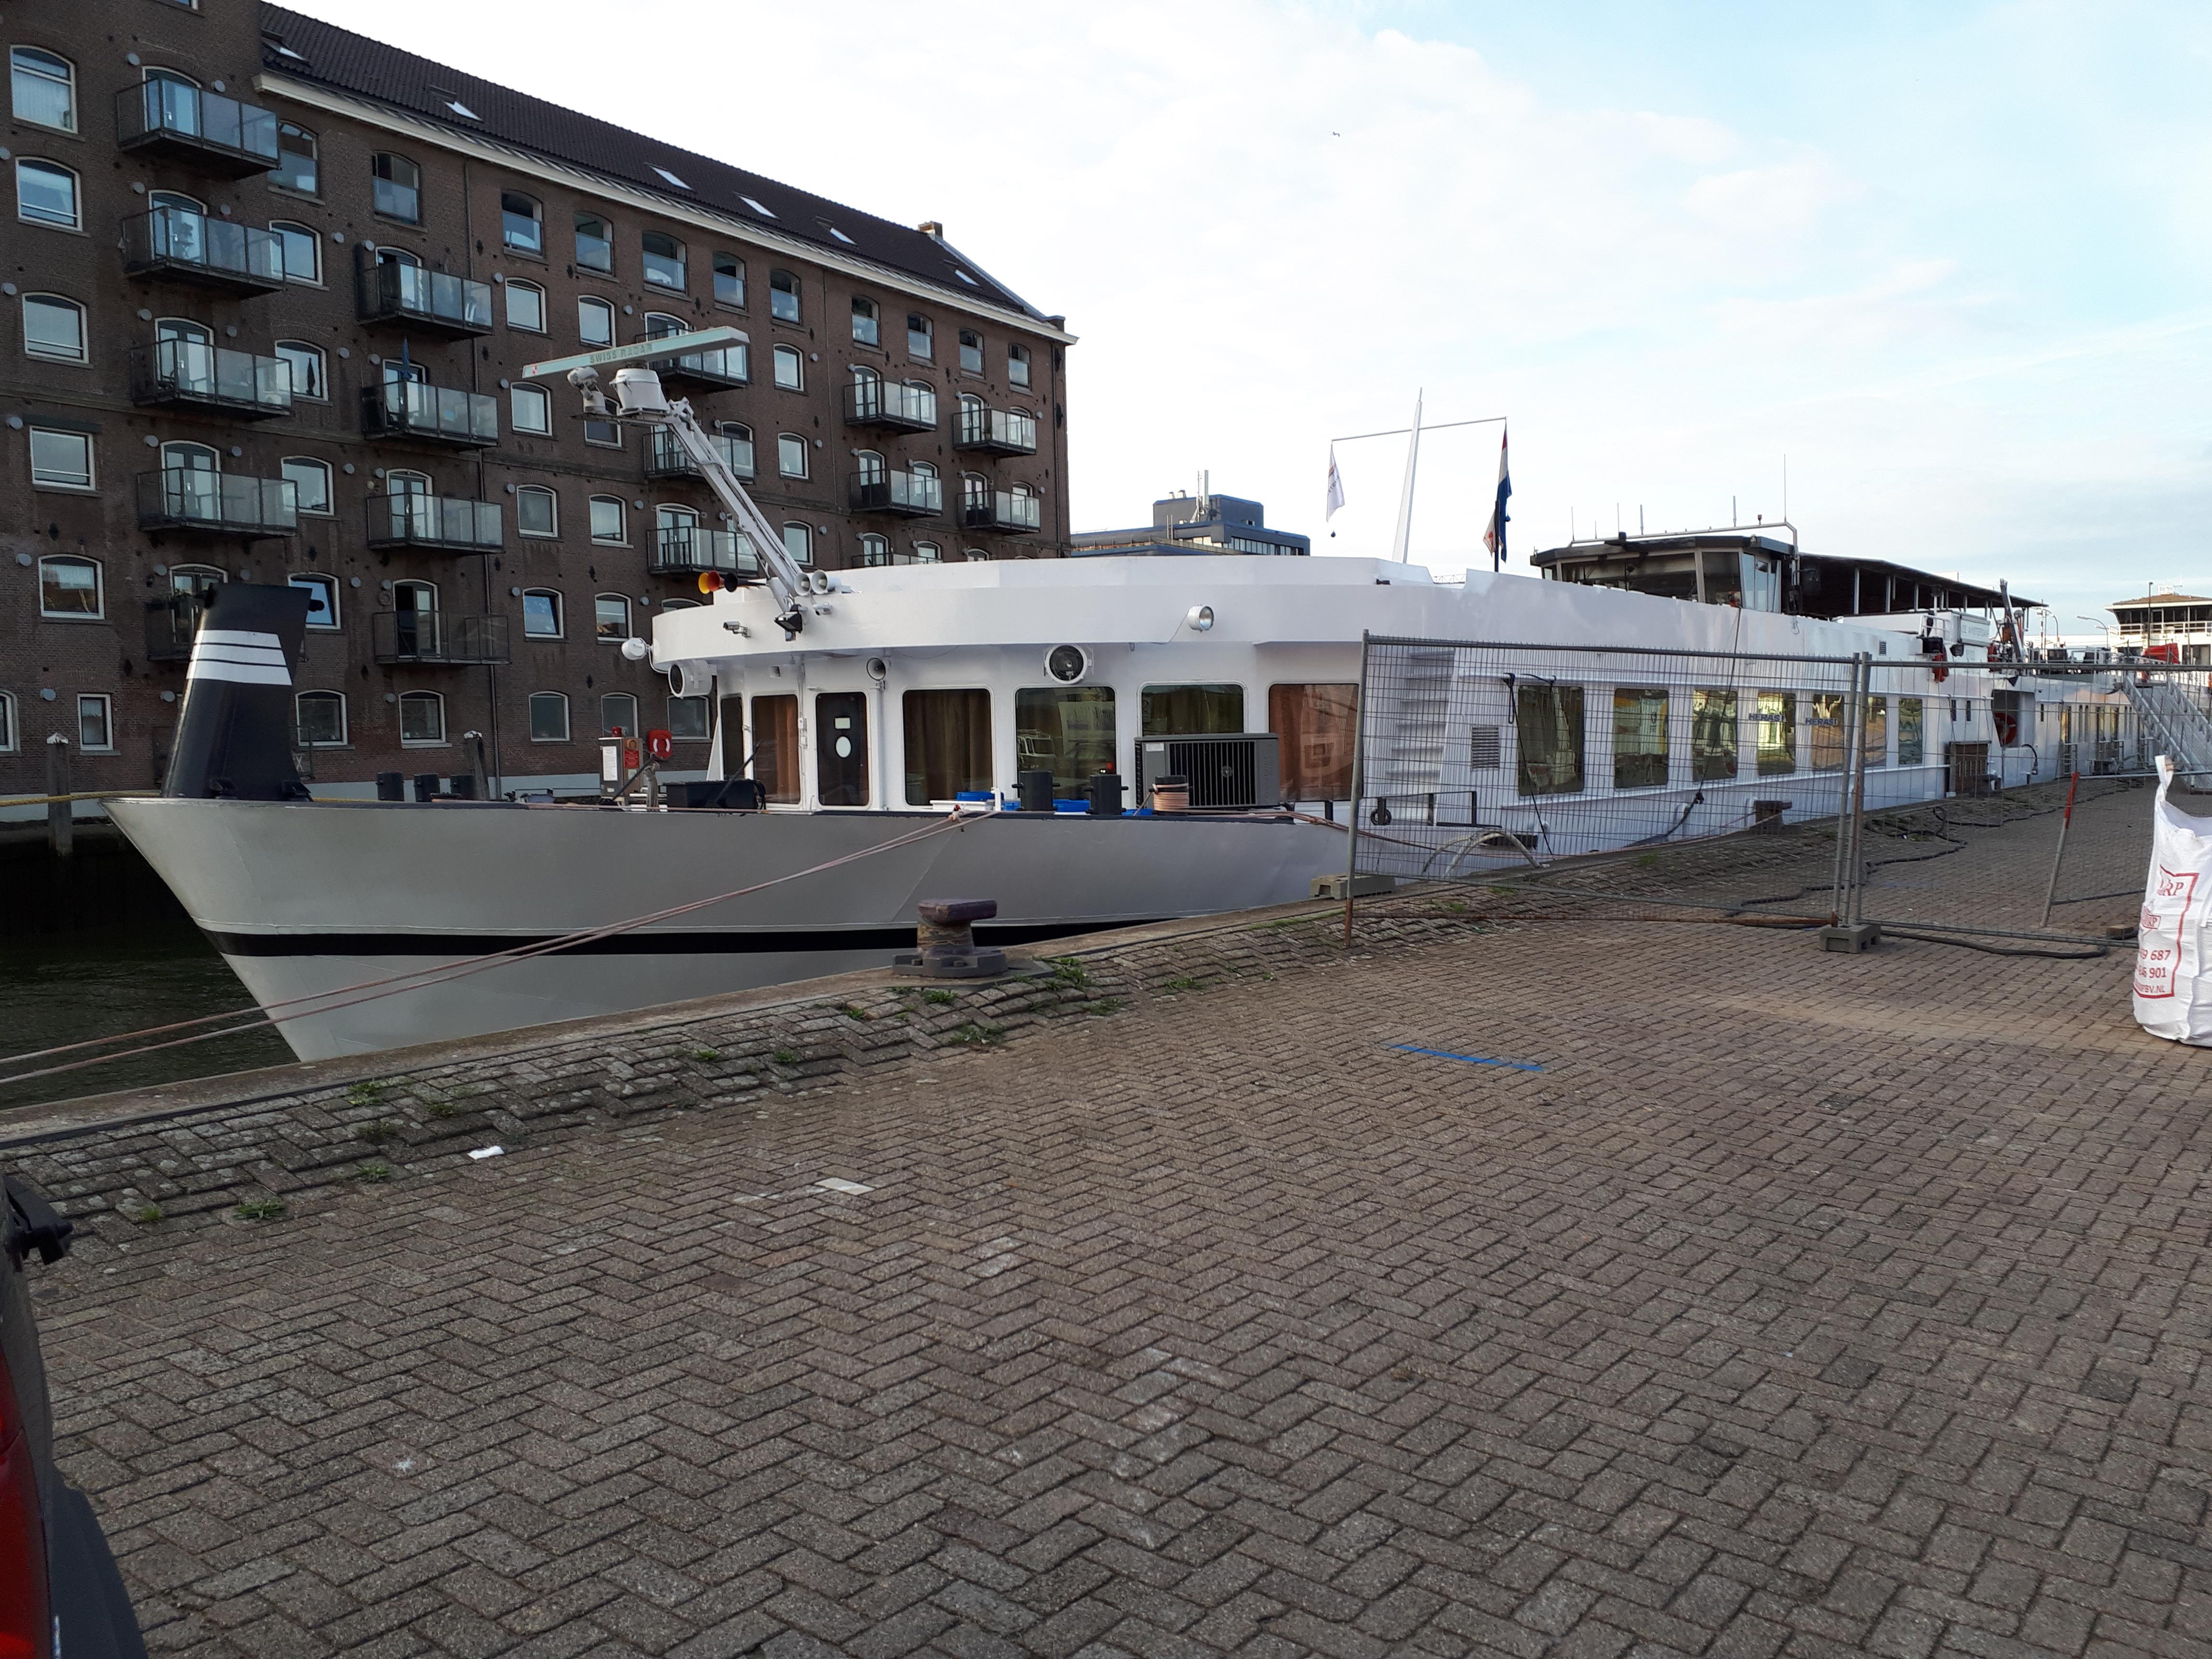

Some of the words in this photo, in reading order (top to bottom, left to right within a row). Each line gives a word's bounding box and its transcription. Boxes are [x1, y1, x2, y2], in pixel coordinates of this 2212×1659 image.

[590, 350, 617, 363] SWISS
[621, 344, 653, 358] RADAR
[2151, 950, 2171, 961] 687
[2149, 967, 2166, 978] 901
